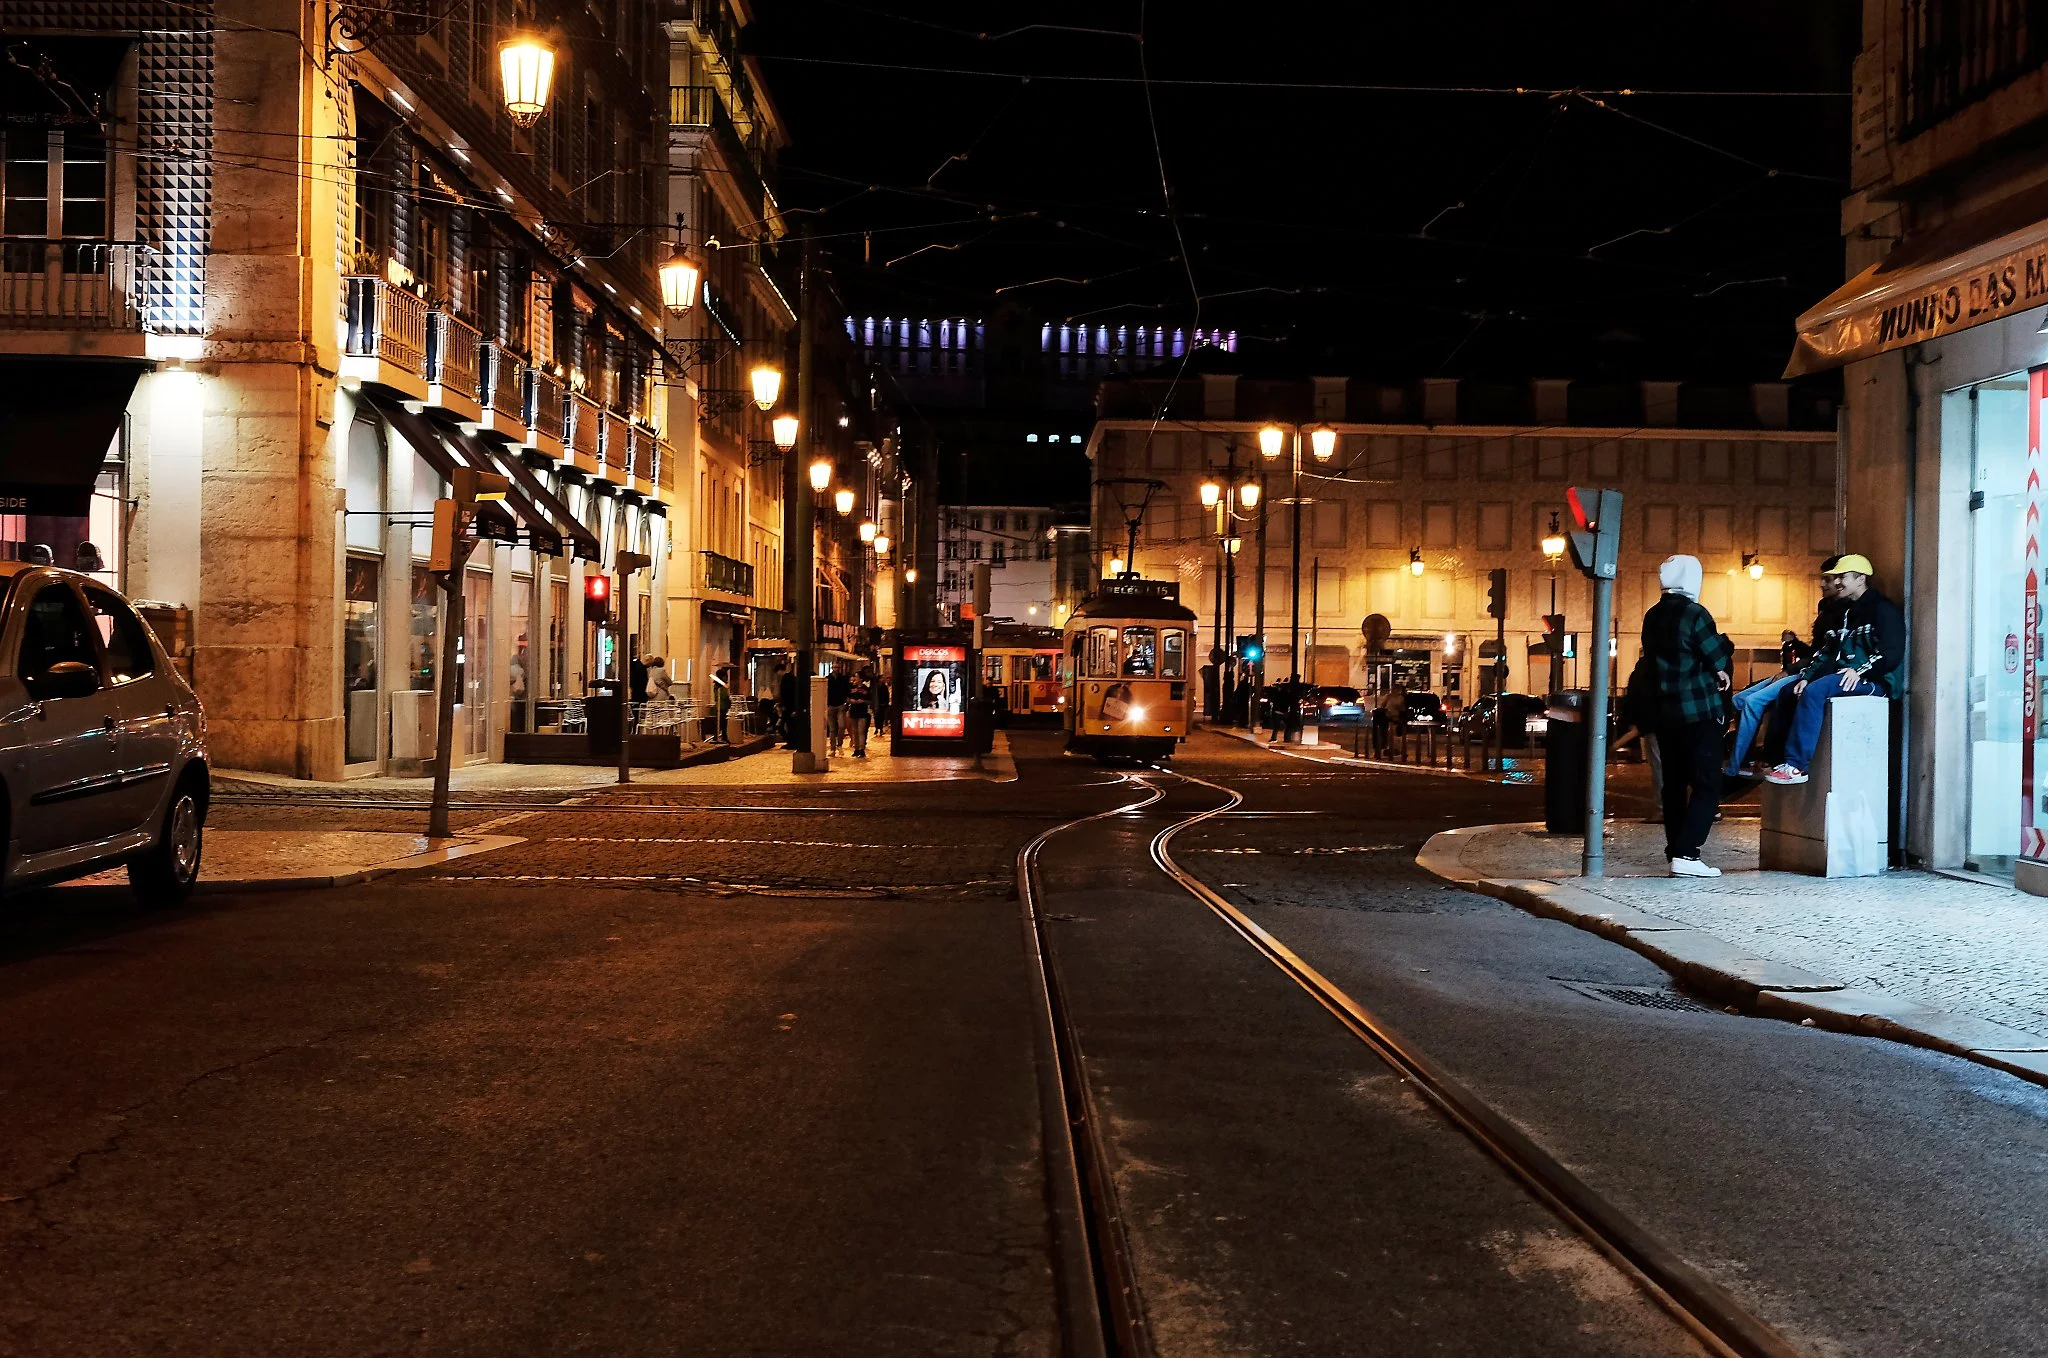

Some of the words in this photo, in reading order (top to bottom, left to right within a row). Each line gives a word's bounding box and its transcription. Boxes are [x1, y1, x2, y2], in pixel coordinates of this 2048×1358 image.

[1969, 266, 2017, 317] DAS
[2025, 253, 2048, 299] M
[2025, 595, 2036, 718] QUALIDADE
